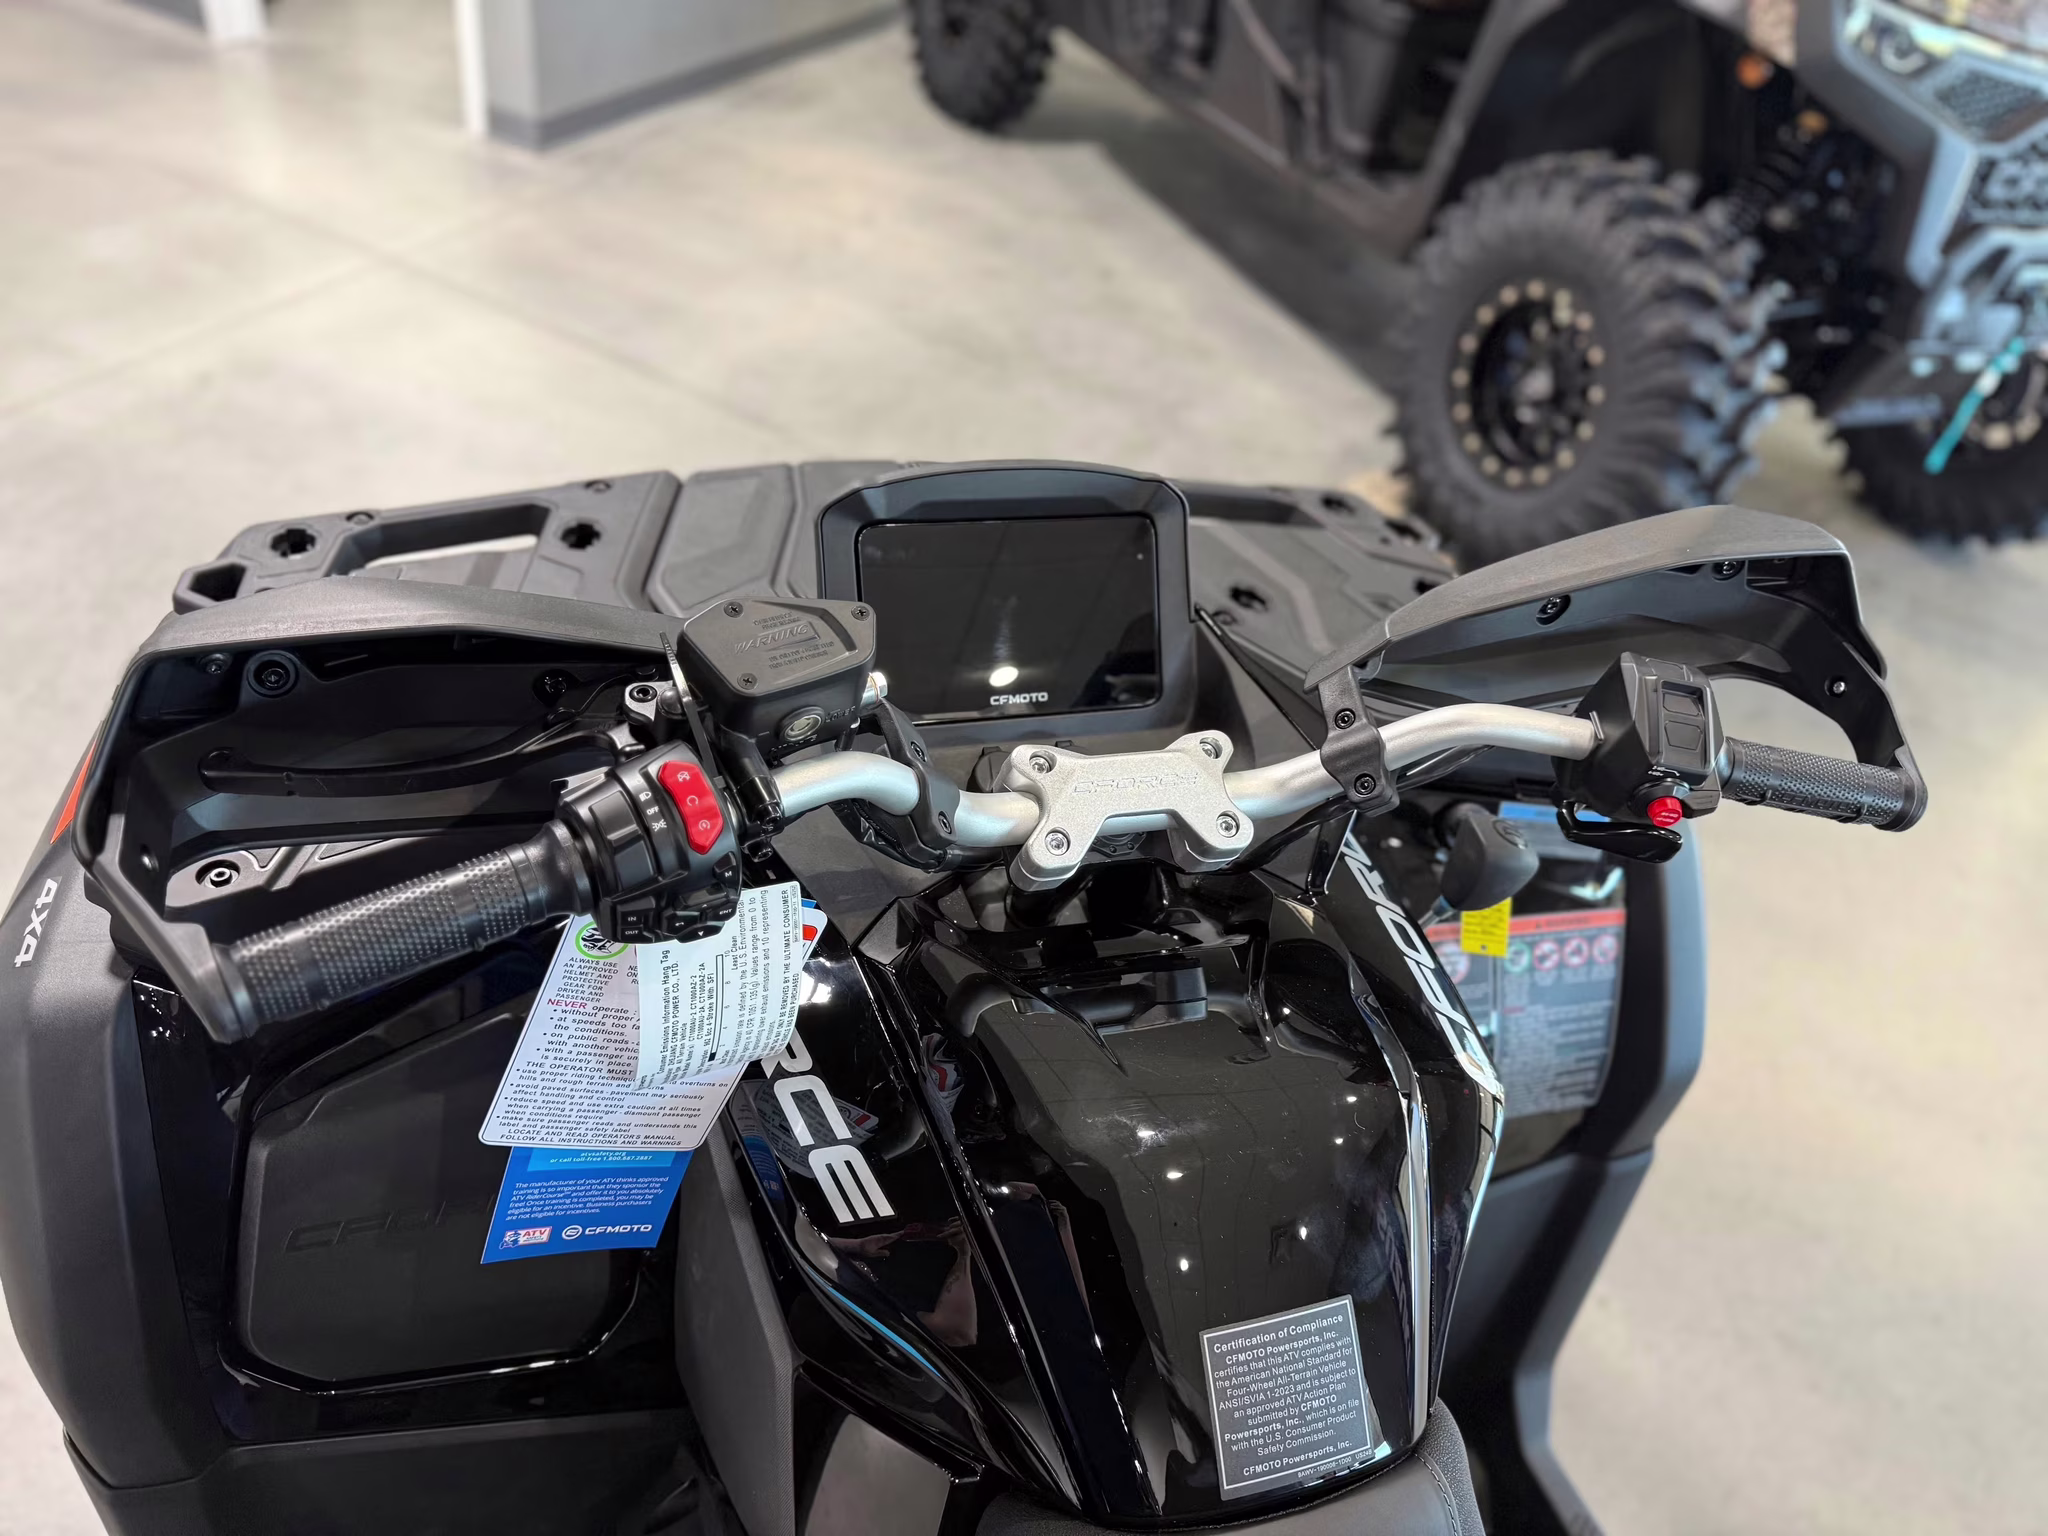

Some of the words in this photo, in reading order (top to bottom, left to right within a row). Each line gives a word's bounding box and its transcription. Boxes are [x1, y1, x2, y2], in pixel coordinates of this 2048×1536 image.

[735, 624, 808, 655] WARNING
[990, 691, 1049, 706] CFMOTO
[646, 806, 659, 815] OFF
[748, 896, 755, 905] to
[782, 889, 790, 928] CONSUMER
[760, 889, 770, 936] representing
[14, 878, 58, 968] 4X4
[749, 914, 757, 931] from
[751, 933, 760, 953] range
[761, 936, 769, 945] 10
[783, 930, 791, 960] ULTIMATE
[568, 956, 600, 965] ALWAYS
[660, 949, 670, 964] Tag
[762, 947, 770, 960] and
[576, 964, 618, 974] APPROVED
[671, 960, 679, 976] LTD.
[731, 954, 739, 970] Least
[750, 955, 758, 977] Values
[561, 975, 610, 985] PROTECTIVE
[563, 969, 594, 977] HELMET
[661, 965, 671, 985] Hang
[762, 962, 770, 992] emissions
[782, 976, 789, 984] BY
[557, 986, 585, 995] DRIVER
[671, 978, 680, 993] CO.,
[555, 992, 601, 1002] PASSENGER
[661, 985, 672, 1024] Information
[546, 998, 587, 1009] NEVER
[591, 1005, 629, 1014] operate
[671, 994, 679, 1018] POWER
[561, 1008, 599, 1017] without
[601, 1013, 634, 1021] proper
[571, 1018, 606, 1026] speeds
[574, 1026, 627, 1036] conditions.
[659, 1025, 670, 1053] Emissions
[670, 1019, 679, 1043] CFMOTO
[572, 1042, 609, 1050] another
[552, 1056, 592, 1064] securely
[575, 1050, 624, 1059] passenger
[526, 1060, 545, 1068] THE
[549, 1063, 603, 1073] OPERATOR
[529, 1179, 576, 1187] manufacturer
[522, 1228, 547, 1237] ATV
[584, 1224, 652, 1234] CFMOTO
[1213, 1332, 1276, 1353] Certification
[1278, 1327, 1287, 1338] of
[1289, 1314, 1343, 1335] Compliance
[1225, 1348, 1265, 1364] CFMOTO
[1266, 1335, 1322, 1355] Powersports,
[1323, 1330, 1338, 1340] Inc.
[1214, 1364, 1248, 1378] certifies
[1249, 1359, 1266, 1370] that
[1267, 1355, 1282, 1365] this
[1283, 1349, 1299, 1362] ATV
[1300, 1341, 1335, 1356] complies
[1335, 1336, 1351, 1347] with
[1216, 1380, 1229, 1389] the
[1231, 1370, 1270, 1385] American
[1271, 1359, 1305, 1375] National
[1306, 1349, 1341, 1366] Standard
[1342, 1347, 1352, 1356] for
[1226, 1378, 1276, 1397] Four-Wheel
[1277, 1367, 1317, 1385] All-Terrain
[1318, 1359, 1346, 1373] Vehicle
[1218, 1392, 1265, 1410] ANSI/SVIA
[1266, 1384, 1294, 1398] 1-2023
[1295, 1379, 1311, 1391] and
[1311, 1378, 1319, 1386] is
[1320, 1369, 1348, 1384] subject
[1233, 1409, 1244, 1418] an
[1246, 1397, 1285, 1415] approved
[1285, 1392, 1302, 1405] ATV
[1303, 1387, 1328, 1400] Action
[1328, 1381, 1346, 1392] Plan
[1247, 1407, 1288, 1425] submitted
[1289, 1406, 1299, 1415] by
[1300, 1394, 1336, 1411] CFMOTO
[1224, 1422, 1284, 1442] Powersports,
[1285, 1417, 1304, 1426] Inc.,
[1305, 1408, 1328, 1420] which
[1328, 1406, 1336, 1414] is
[1337, 1403, 1347, 1411] on
[1347, 1398, 1359, 1408] file
[1230, 1440, 1249, 1451] with
[1250, 1437, 1264, 1446] the
[1265, 1431, 1283, 1442] U.S.
[1285, 1420, 1325, 1437] Consumer
[1326, 1410, 1356, 1425] Product
[1257, 1443, 1284, 1455] Safety
[1285, 1428, 1336, 1448] Commission.
[1243, 1459, 1281, 1475] CFMOTO
[1282, 1445, 1336, 1465] Powersports,
[1337, 1440, 1352, 1449] Inc.
